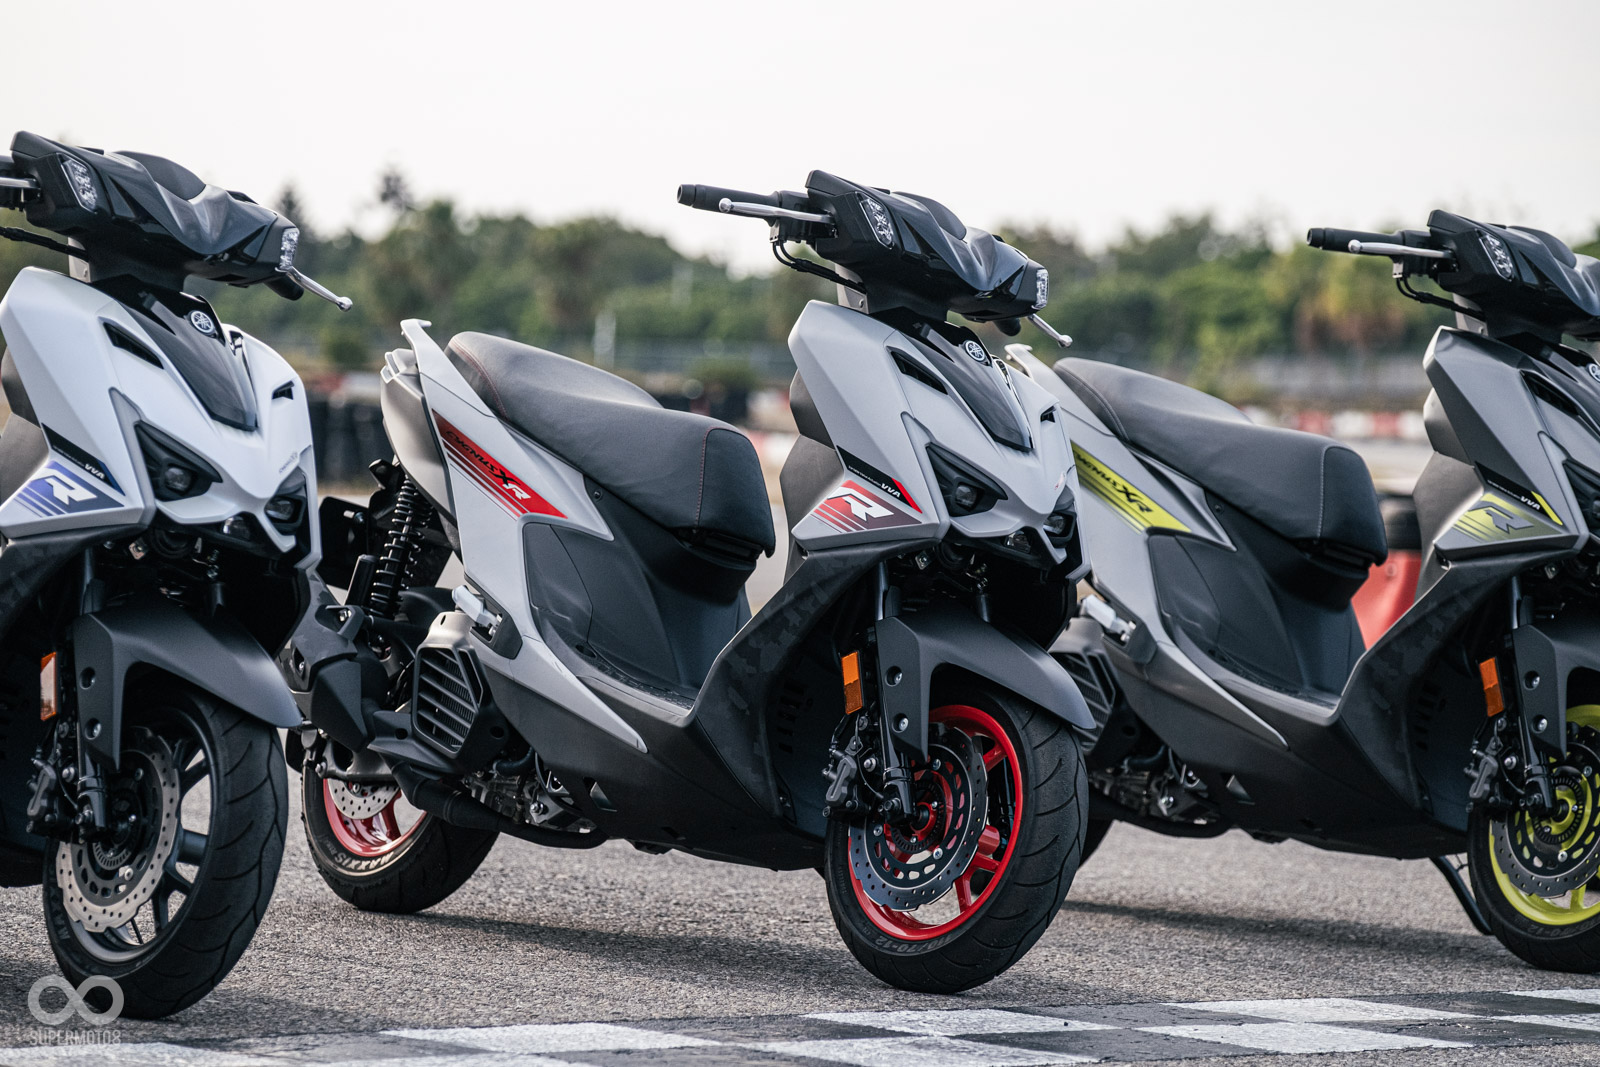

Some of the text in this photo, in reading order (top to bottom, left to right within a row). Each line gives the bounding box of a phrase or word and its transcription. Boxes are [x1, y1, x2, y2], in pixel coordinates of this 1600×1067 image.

[84, 463, 105, 480] VVA
[880, 483, 901, 498] VVA
[1520, 495, 1541, 511] VVA
[334, 851, 394, 871] MAXXIS
